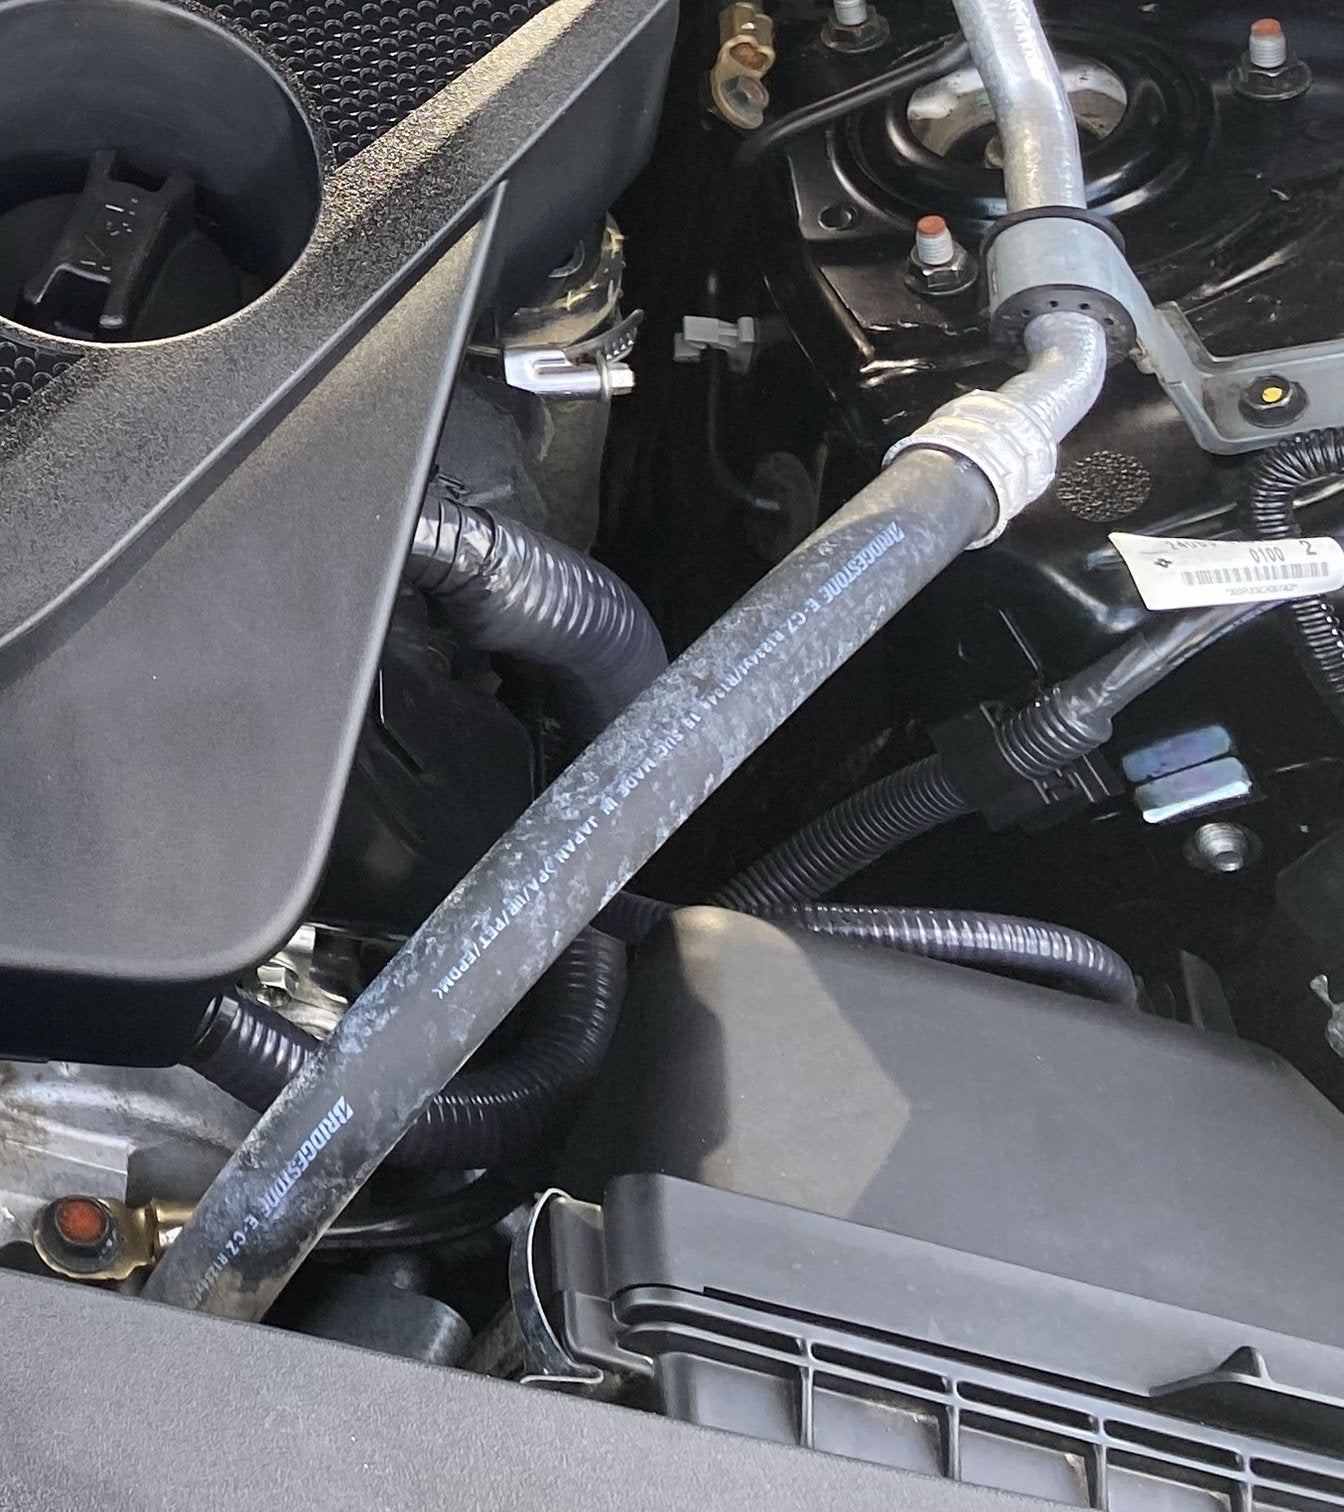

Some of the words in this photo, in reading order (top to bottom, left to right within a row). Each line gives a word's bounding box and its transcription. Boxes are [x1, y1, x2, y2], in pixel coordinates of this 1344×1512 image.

[819, 521, 905, 603] BRIDGESTONE
[617, 758, 657, 798] MADE
[599, 796, 619, 816] IN
[554, 815, 599, 864] JAPAN
[261, 1095, 354, 1217] BRIDGESTONE
